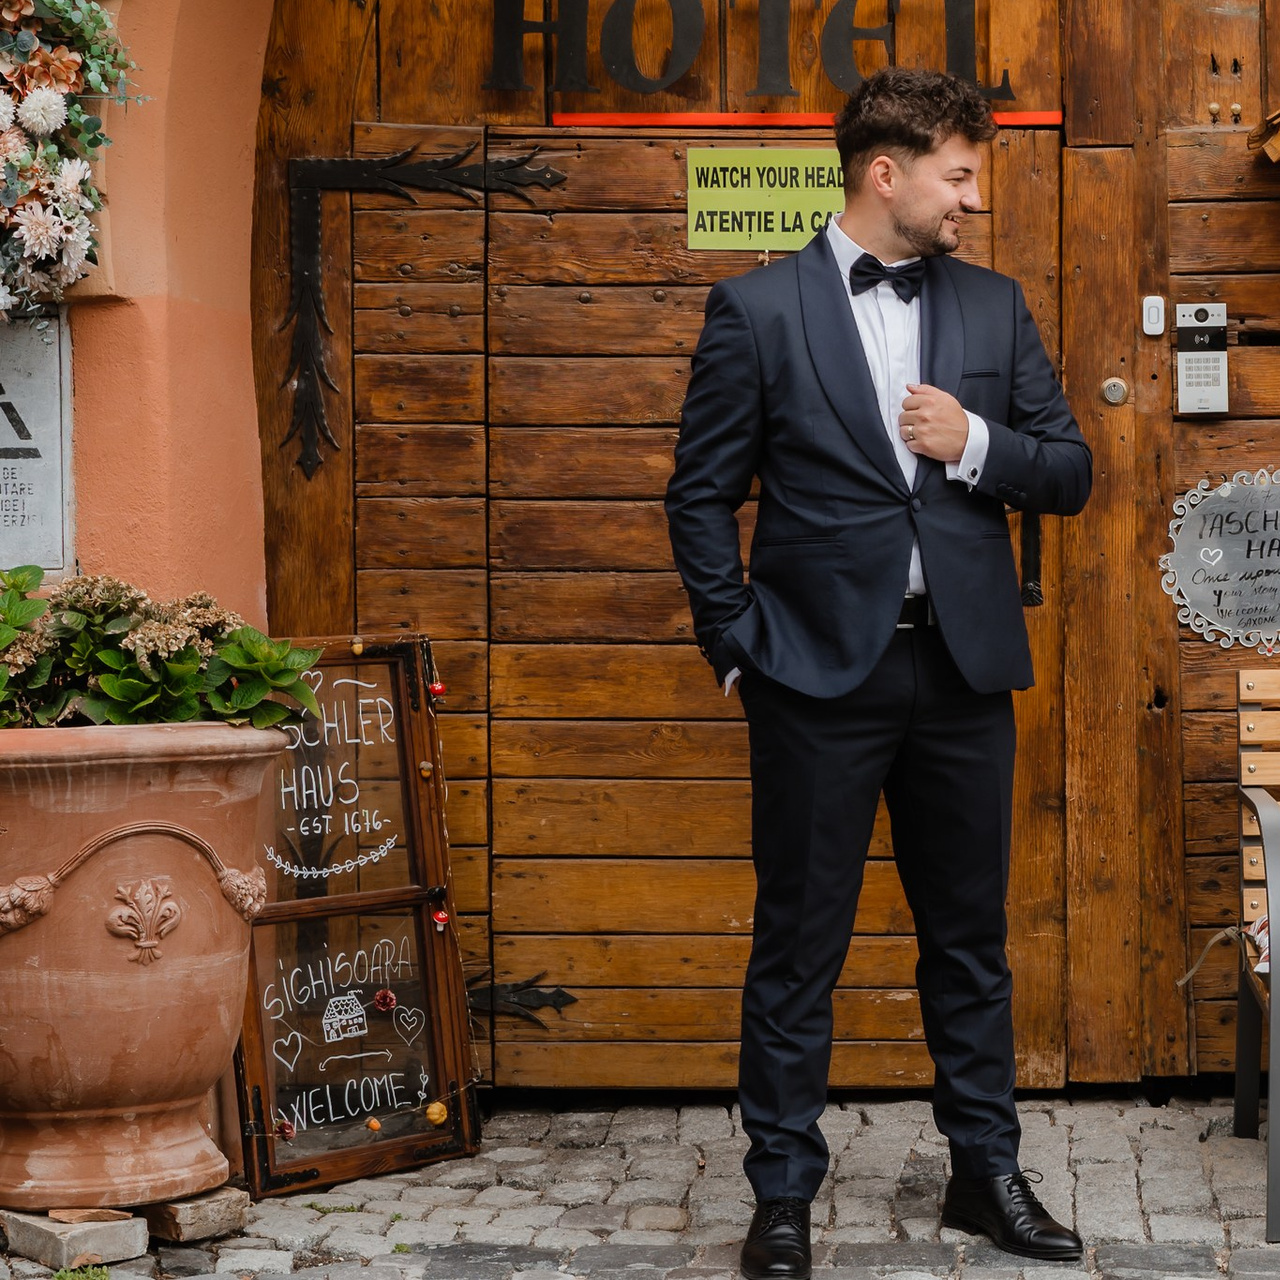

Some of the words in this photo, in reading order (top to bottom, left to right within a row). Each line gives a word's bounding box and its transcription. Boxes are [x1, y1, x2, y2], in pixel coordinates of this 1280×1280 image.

[695, 166, 751, 188] WATCH
[756, 166, 800, 188] YOUR
[694, 210, 775, 241] ATENȚIE
[781, 211, 804, 232] LA
[810, 210, 843, 232] CA
[1191, 568, 1230, 586] Once
[1253, 583, 1279, 601] story
[1216, 605, 1270, 620] WELCOME
[280, 761, 360, 810] HAUS
[270, 1073, 411, 1131] WELCOME
